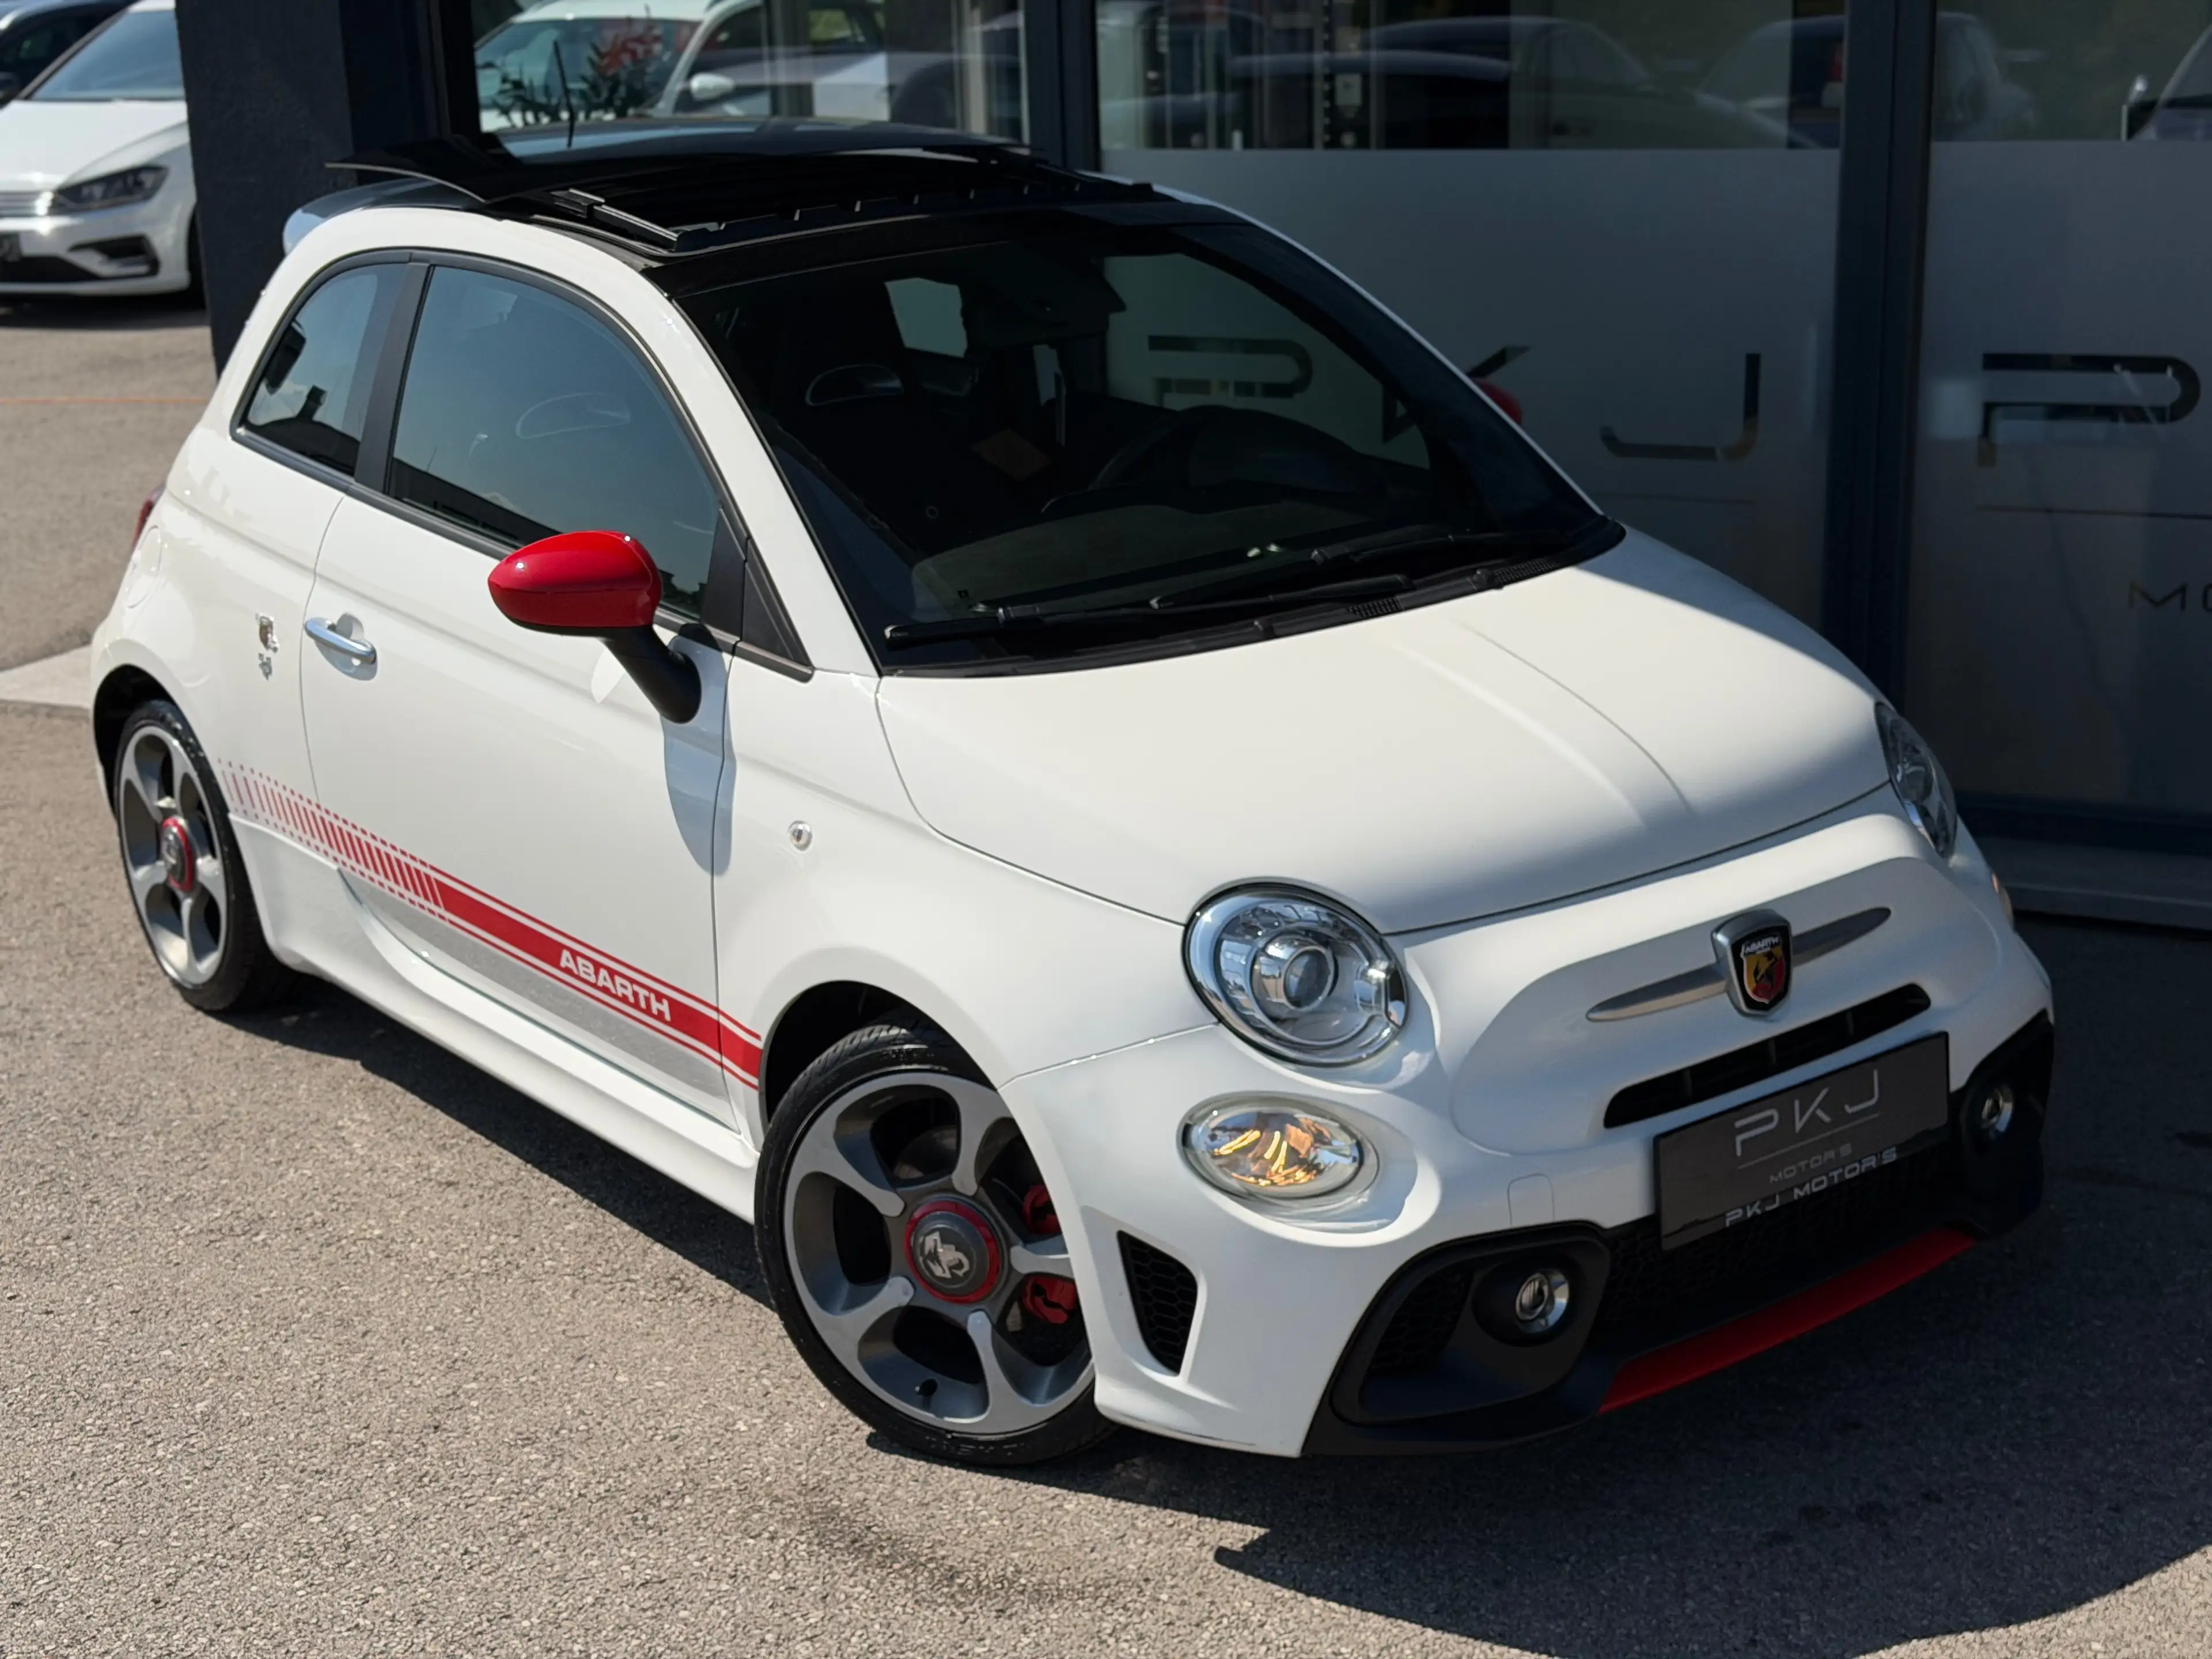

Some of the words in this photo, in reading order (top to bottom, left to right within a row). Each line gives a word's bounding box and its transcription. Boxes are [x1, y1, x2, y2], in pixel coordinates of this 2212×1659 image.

[559, 949, 671, 1021] ABARTH
[1734, 1069, 1879, 1157] PKJ
[1725, 1193, 1780, 1227] PKJ
